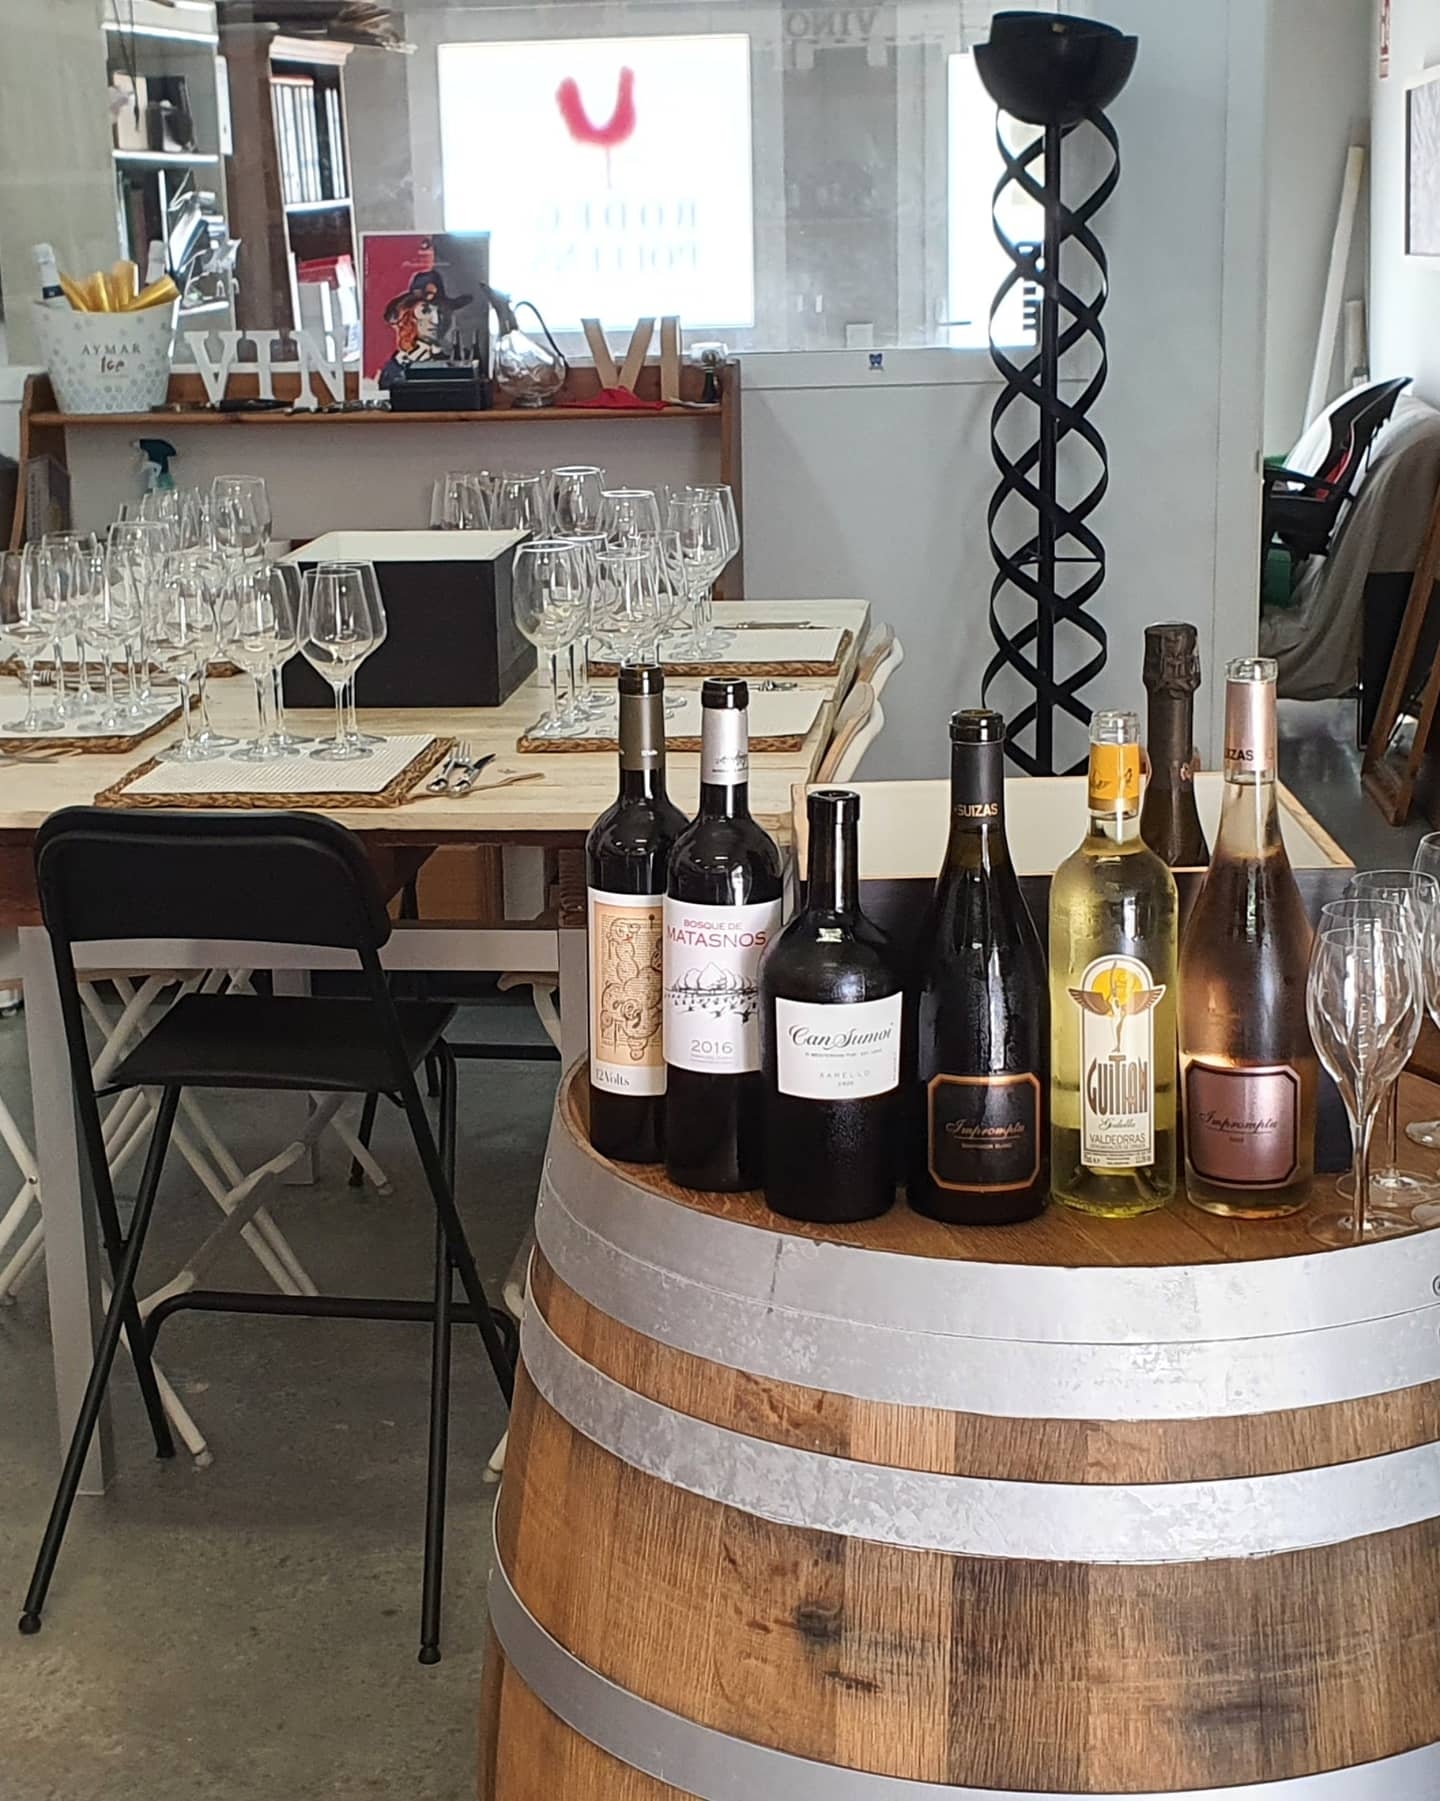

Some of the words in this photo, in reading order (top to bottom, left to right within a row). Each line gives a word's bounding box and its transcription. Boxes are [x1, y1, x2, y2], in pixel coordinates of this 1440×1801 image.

[81, 343, 142, 356] AYMAR
[683, 919, 725, 930] BOSQUE
[727, 921, 745, 930] DE
[667, 924, 767, 948] MATASNOS
[788, 1024, 831, 1048] Can
[690, 1039, 733, 1055] 2016
[1089, 1132, 1147, 1145] VALDEORRAS
